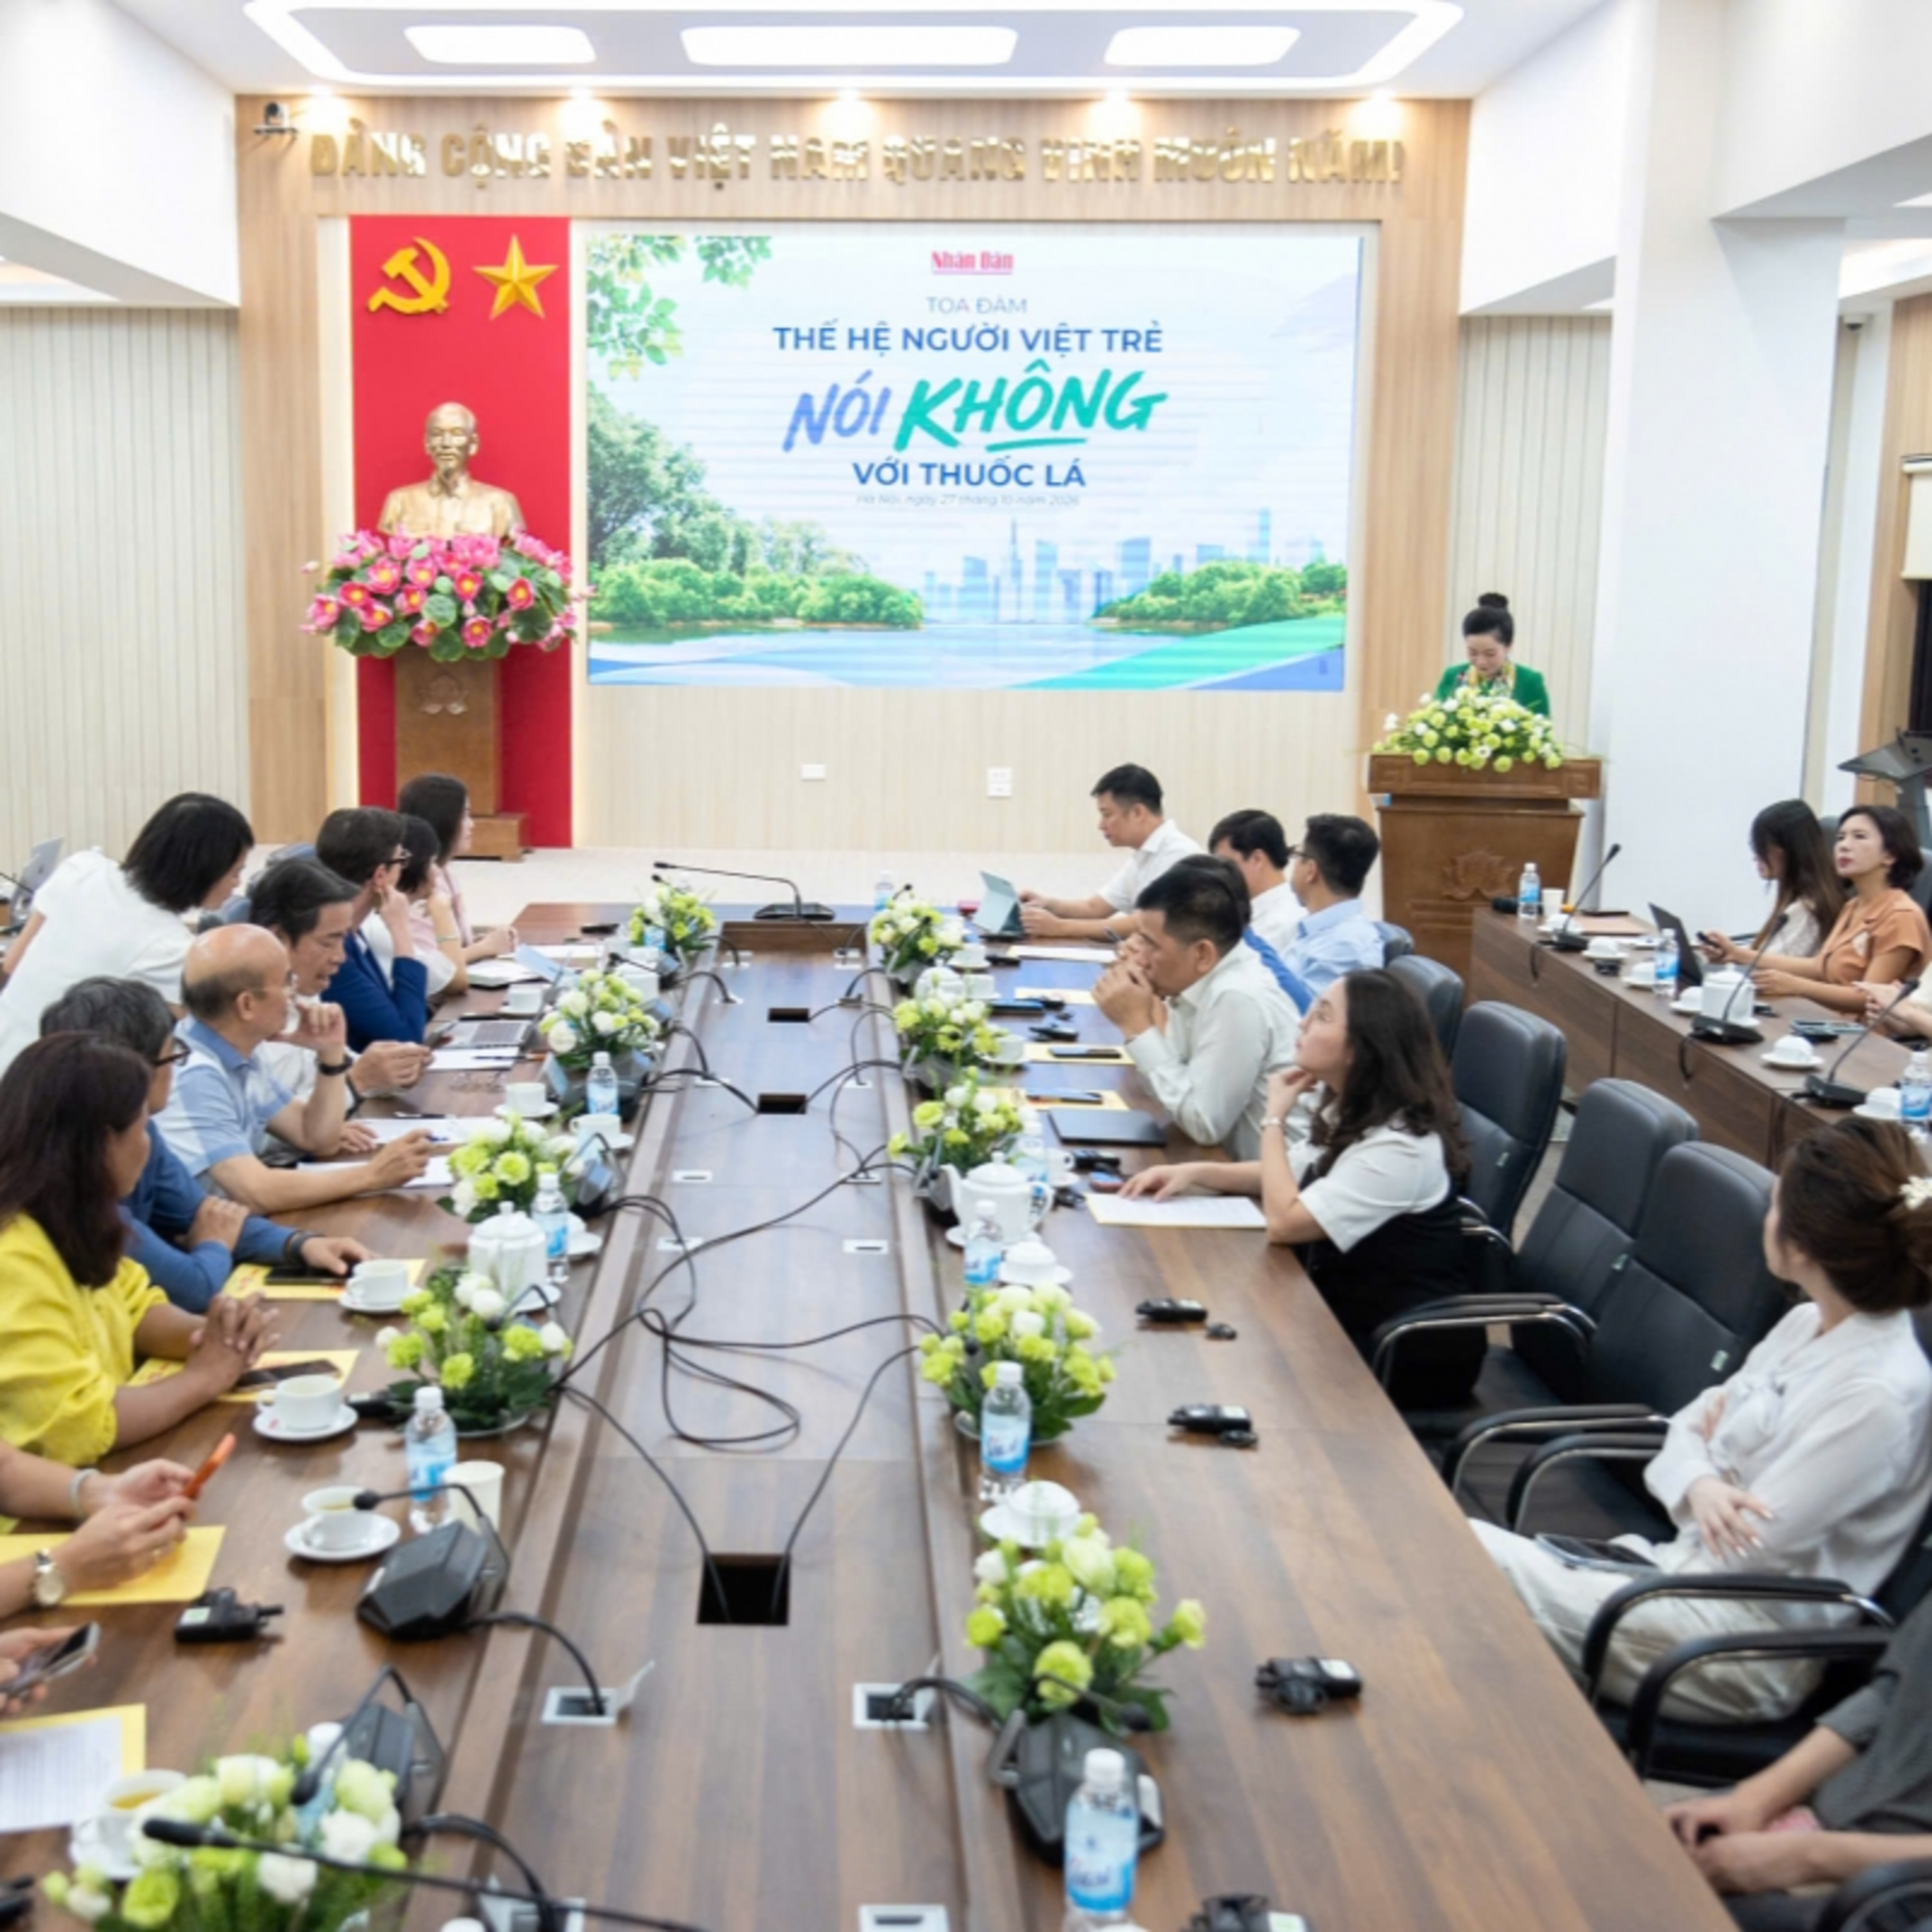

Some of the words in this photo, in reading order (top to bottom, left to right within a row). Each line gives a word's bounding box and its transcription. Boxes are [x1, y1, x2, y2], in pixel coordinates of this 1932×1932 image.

[773, 319, 838, 350] THẾ
[848, 321, 891, 357] HỆ
[902, 323, 1009, 352] NGƯỜI
[1019, 322, 1092, 358] VIỆT
[1101, 320, 1163, 352] TRẺ
[782, 369, 892, 452] NÓI
[893, 359, 1168, 452] KHÔNG
[852, 456, 909, 486] VỚI
[919, 455, 1034, 487] THUỐC
[1045, 458, 1086, 488] LÁ
